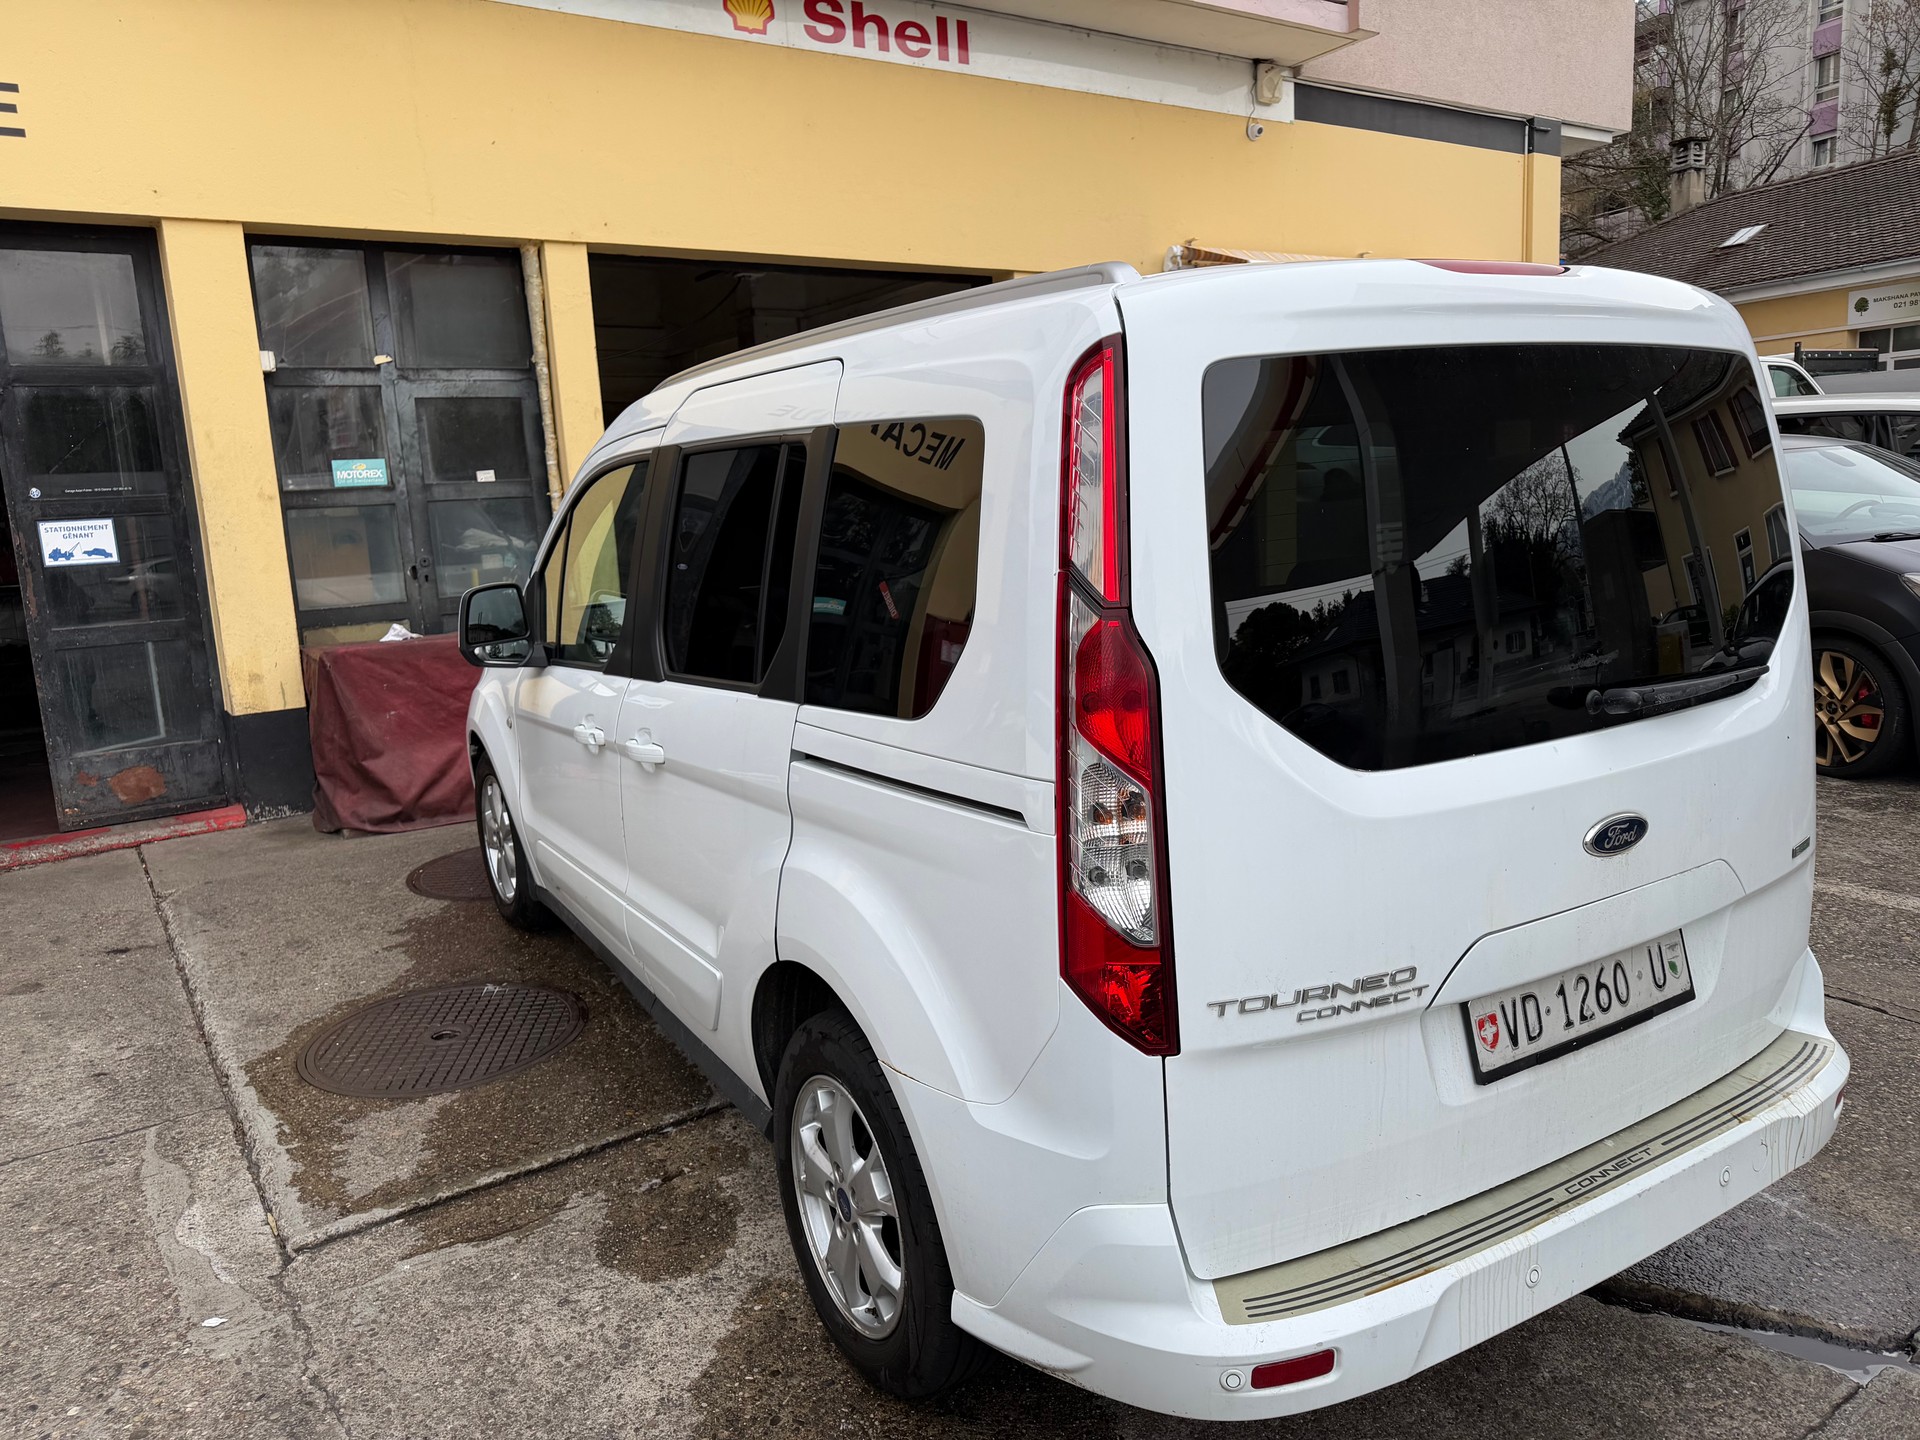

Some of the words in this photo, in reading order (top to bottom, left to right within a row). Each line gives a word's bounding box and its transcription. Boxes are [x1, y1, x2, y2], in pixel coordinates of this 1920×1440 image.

[803, 0, 970, 65] Shell
[1873, 293, 1909, 302] MAKSHANA
[1893, 301, 1907, 309] 021
[336, 469, 383, 479] MOTOREX
[44, 523, 109, 534] STATIONNEMENT
[62, 532, 94, 540] GÊNANT
[1604, 822, 1638, 849] Ford
[1206, 965, 1418, 1018] TOURNEO
[1295, 983, 1430, 1023] CONNECT
[1564, 1147, 1652, 1195] CONNECT
